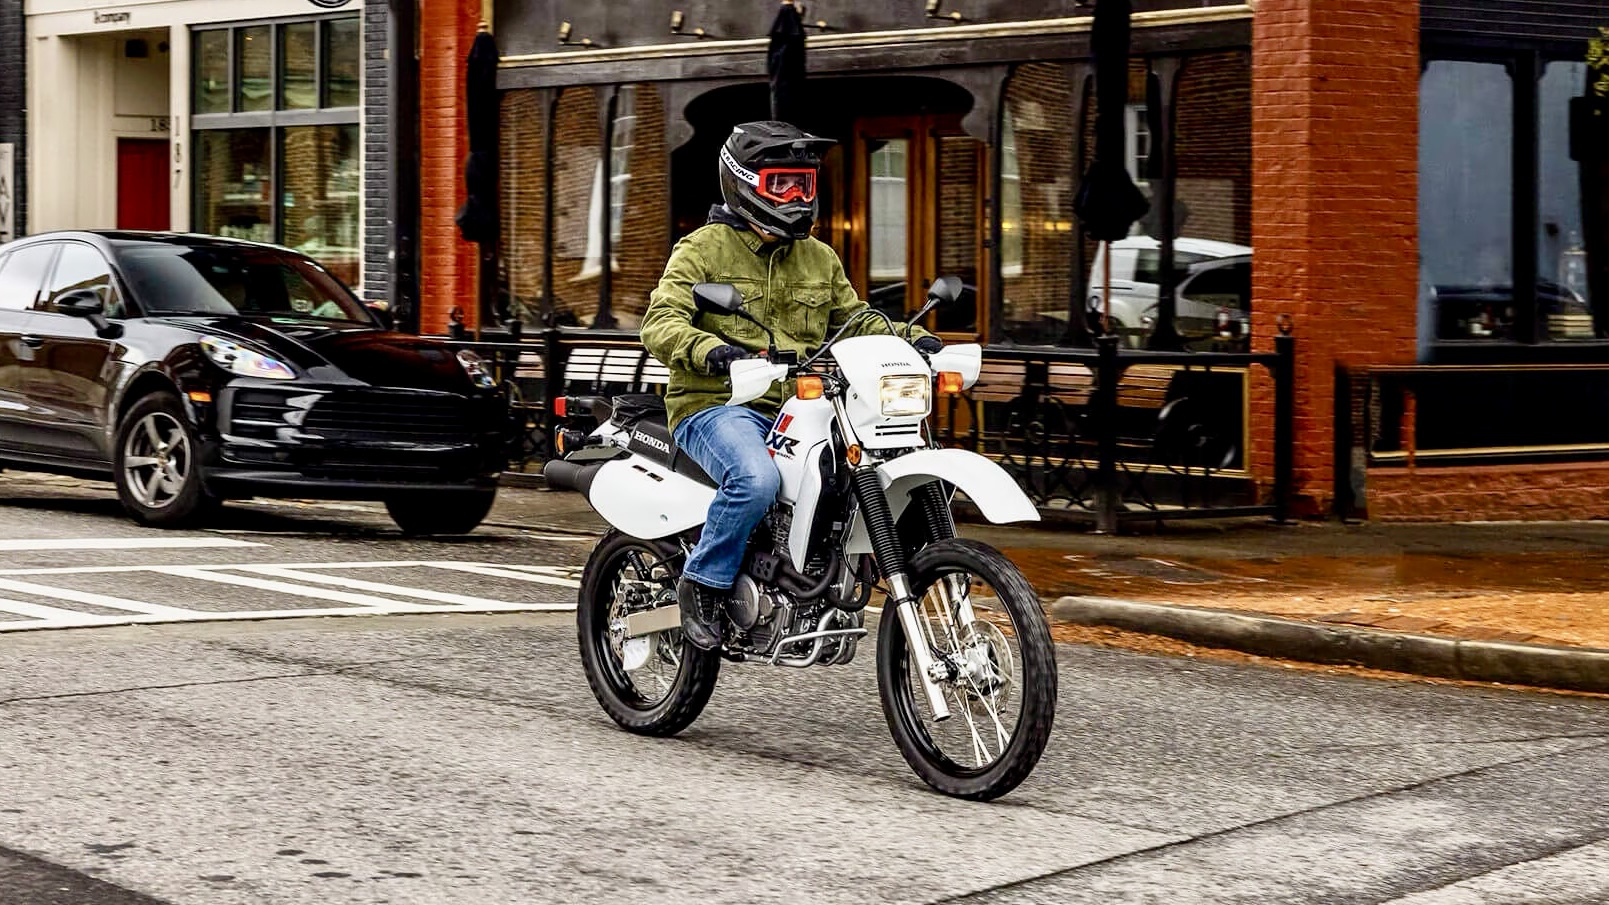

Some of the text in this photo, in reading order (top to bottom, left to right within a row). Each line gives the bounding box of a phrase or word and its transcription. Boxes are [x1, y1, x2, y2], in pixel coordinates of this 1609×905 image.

[725, 156, 755, 181] RACING
[633, 430, 670, 454] HONDA
[765, 431, 801, 456] XR
